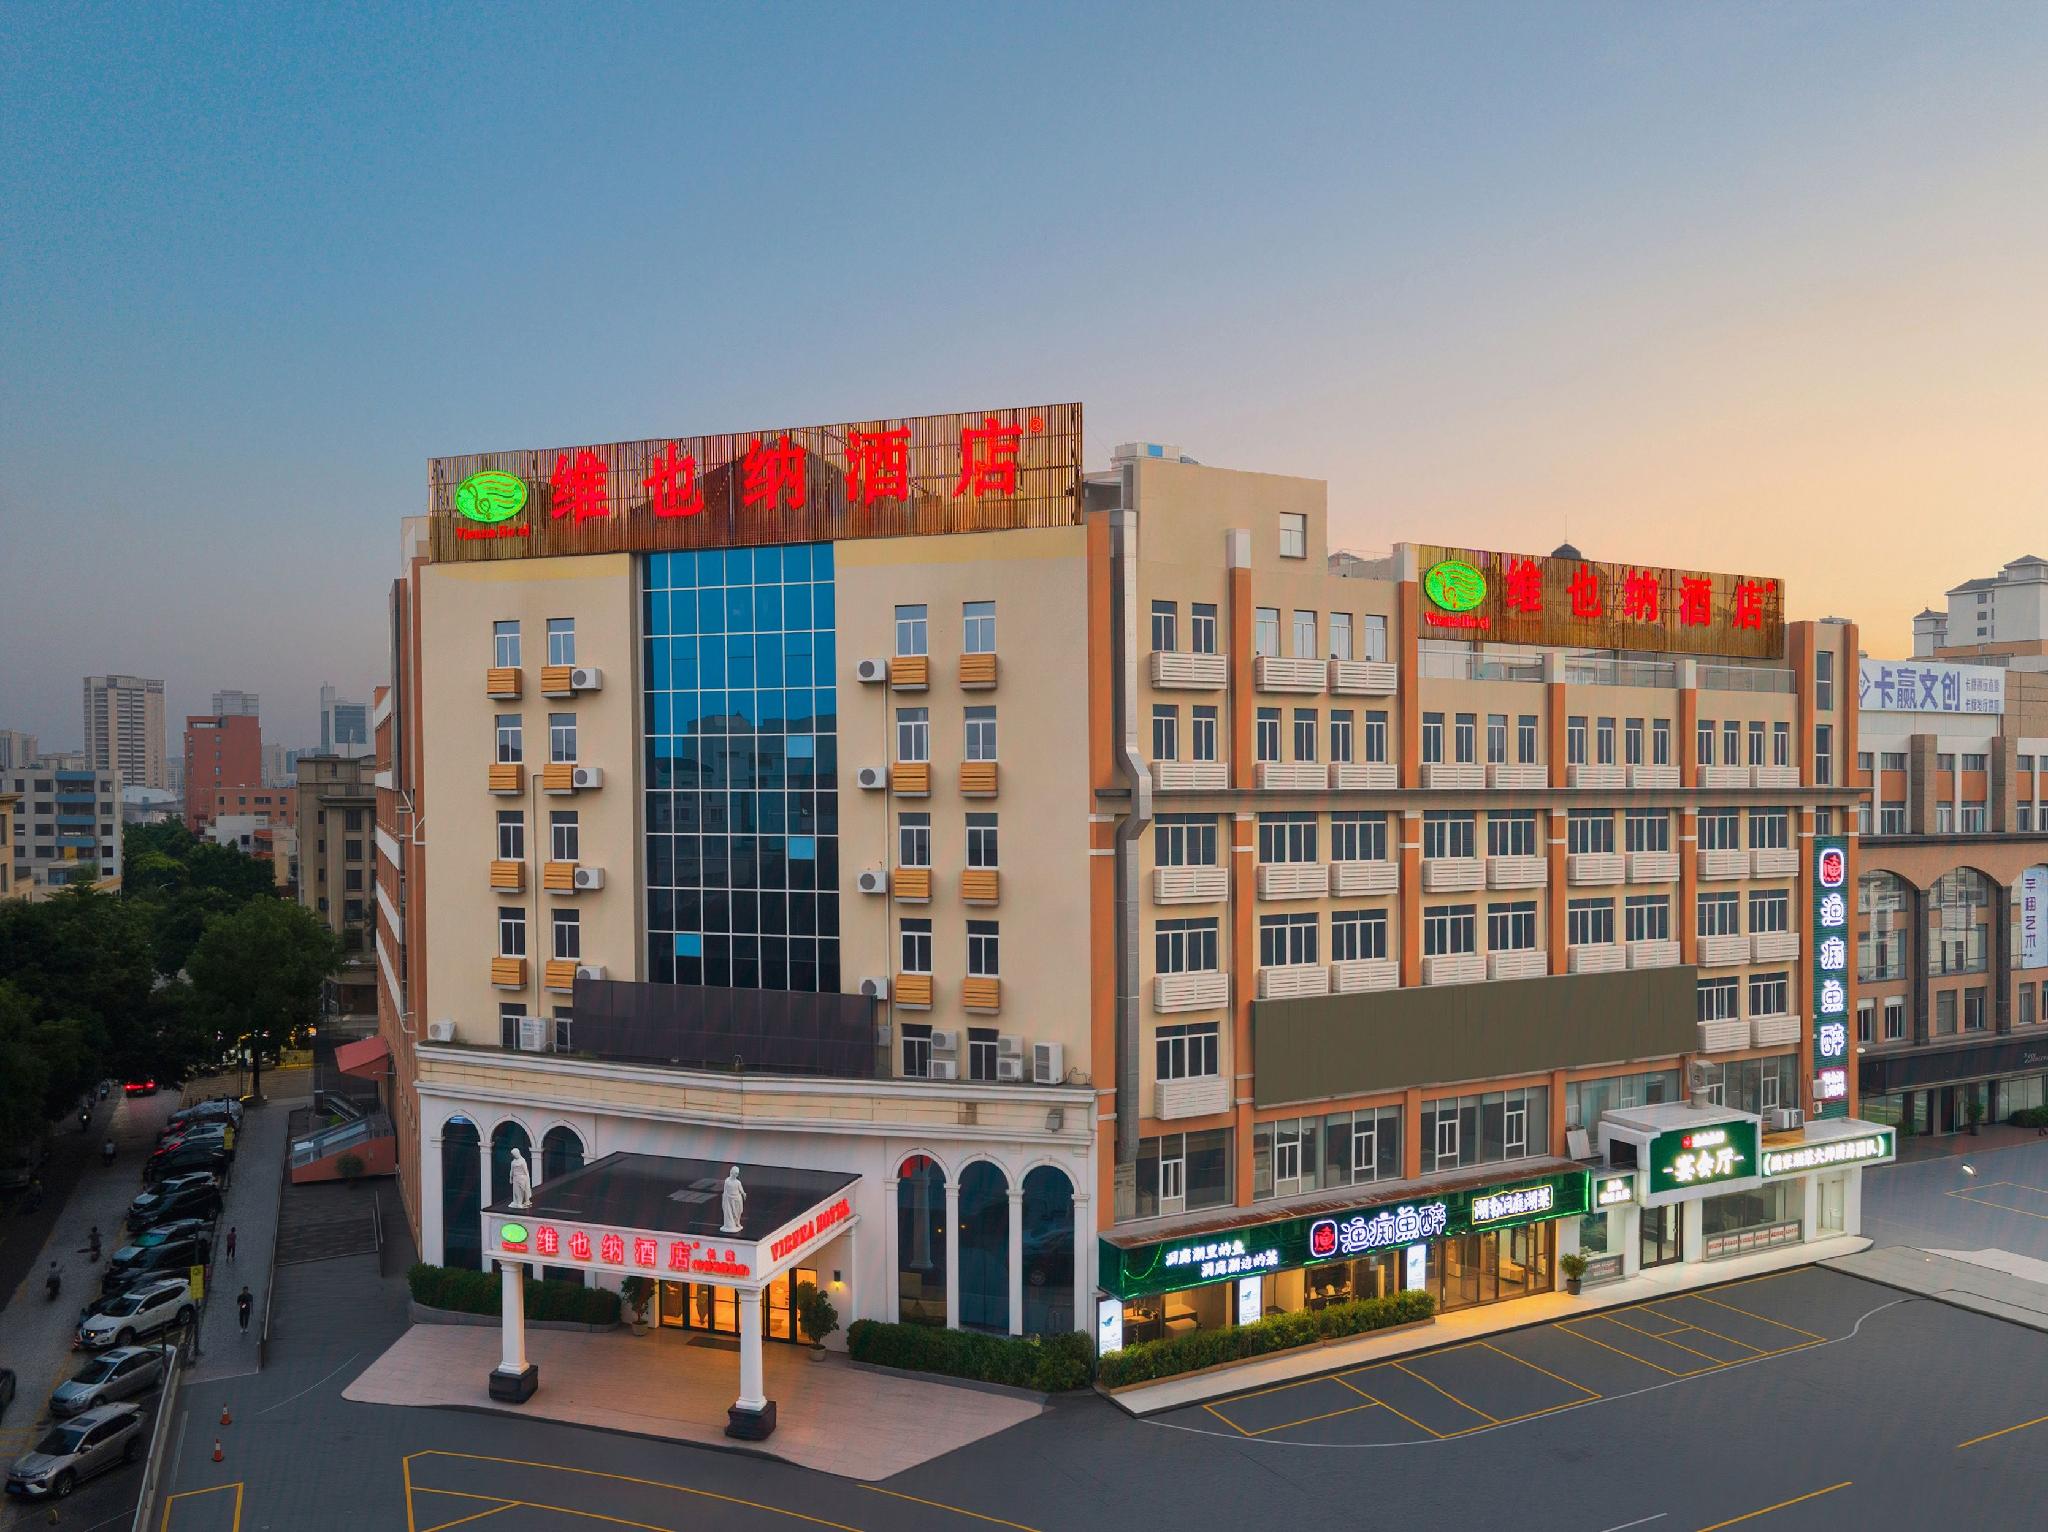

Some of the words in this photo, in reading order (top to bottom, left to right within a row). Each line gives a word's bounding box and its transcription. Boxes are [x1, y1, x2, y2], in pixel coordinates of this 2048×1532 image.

[550, 418, 1024, 525] 维也纳酒店
[1506, 559, 1765, 630] 维也纳酒店
[1874, 666, 1961, 712] 卡赢文创
[537, 1225, 691, 1271] 维也纳酒店
[771, 1220, 815, 1262] VIENNA
